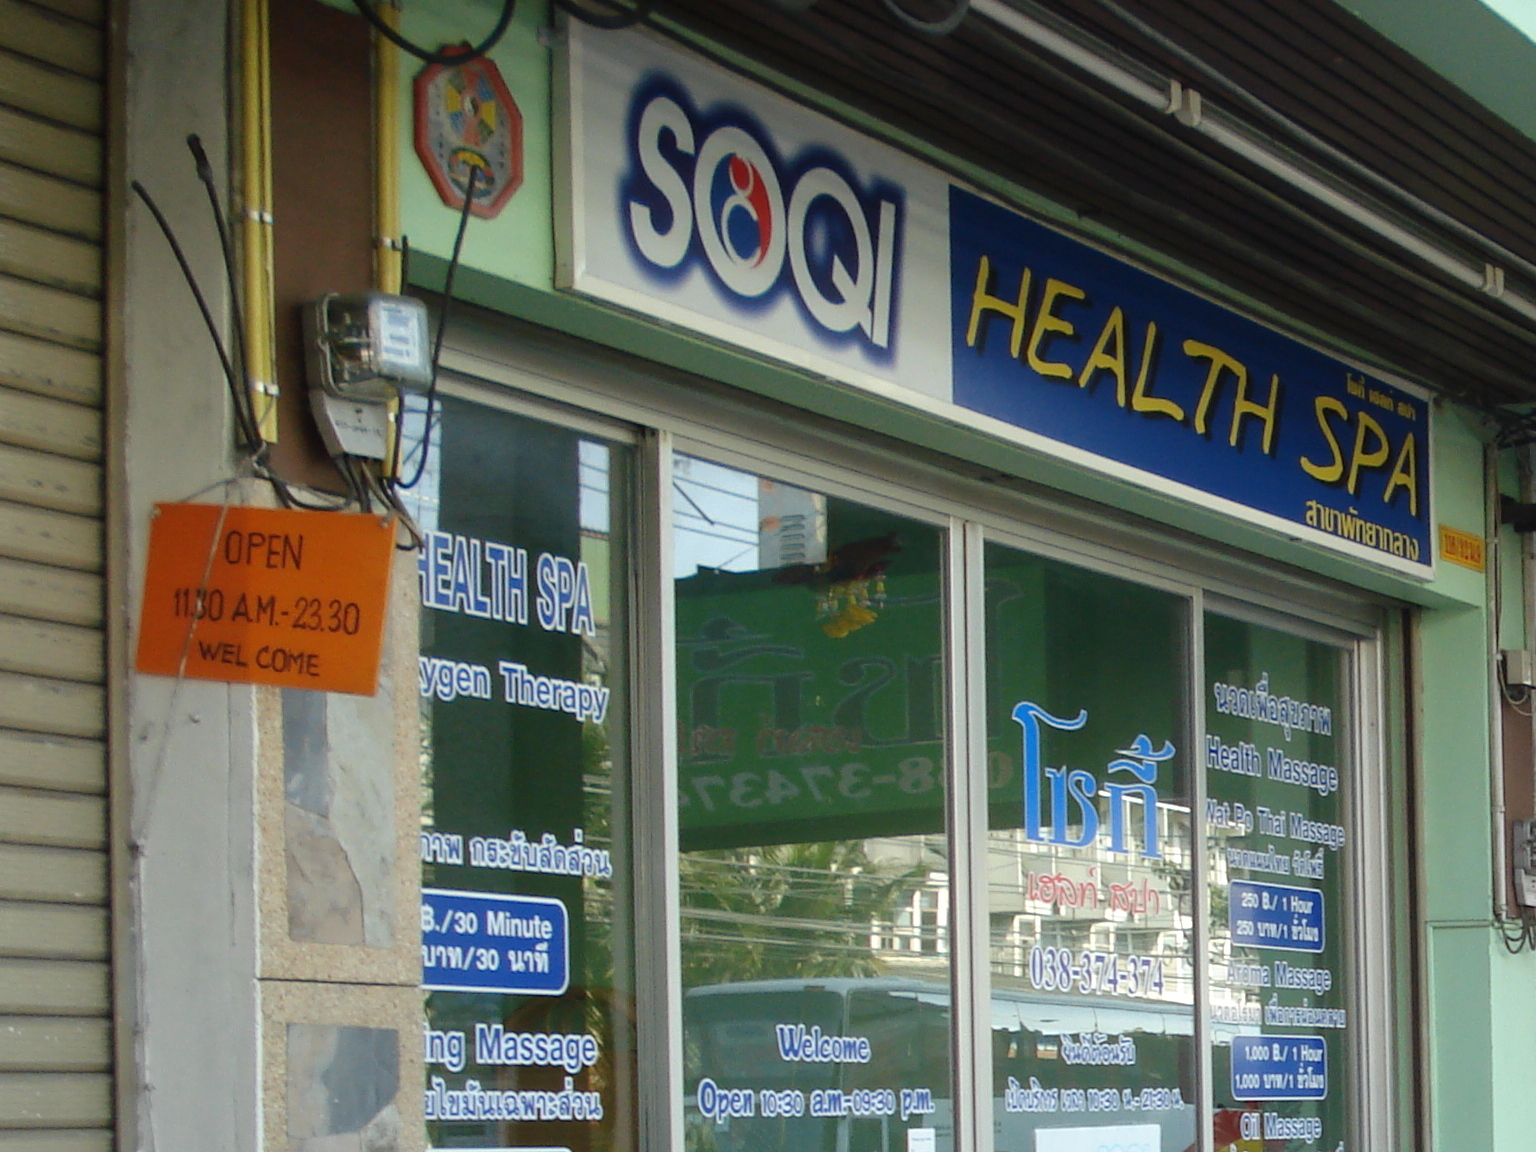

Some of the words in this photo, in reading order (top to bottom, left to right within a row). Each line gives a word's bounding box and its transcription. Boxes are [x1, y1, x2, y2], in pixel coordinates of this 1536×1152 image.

[627, 94, 898, 350] SOQI
[966, 255, 1280, 455] HEALTH
[1300, 396, 1417, 517] SPA
[225, 530, 304, 570] OPEN
[1306, 500, 1419, 561] สาขาพัทยากลาง
[536, 552, 596, 637] SPA
[419, 655, 492, 702] ygen
[498, 660, 610, 724] Therapy
[1214, 671, 1332, 742] นวดเพื่อสุขภาพ
[1012, 701, 1176, 861] โซกี้
[1206, 734, 1262, 777] Health
[1267, 747, 1338, 796] Massage
[1234, 802, 1254, 832] Po
[1256, 806, 1286, 838] Thai
[1289, 812, 1345, 851] Massage
[469, 828, 613, 877] กระชับสัดส่วน
[1028, 866, 1097, 909] เฮลท์
[1110, 878, 1160, 915] สปา
[1291, 895, 1314, 914] Hour
[486, 910, 553, 939] Minute
[508, 942, 550, 973] นาที
[1029, 946, 1164, 997] 038-374-374
[1227, 961, 1271, 988] Aroma
[1274, 961, 1332, 996] Massage
[475, 1023, 599, 1074] Massage
[776, 1023, 871, 1063] Welcome
[1301, 1044, 1323, 1062] Hour
[697, 1078, 755, 1124] Open
[760, 1089, 804, 1117] 10:30
[900, 1088, 935, 1121] p.m.
[1240, 1112, 1261, 1141] Oil
[1264, 1112, 1322, 1144] Massage
